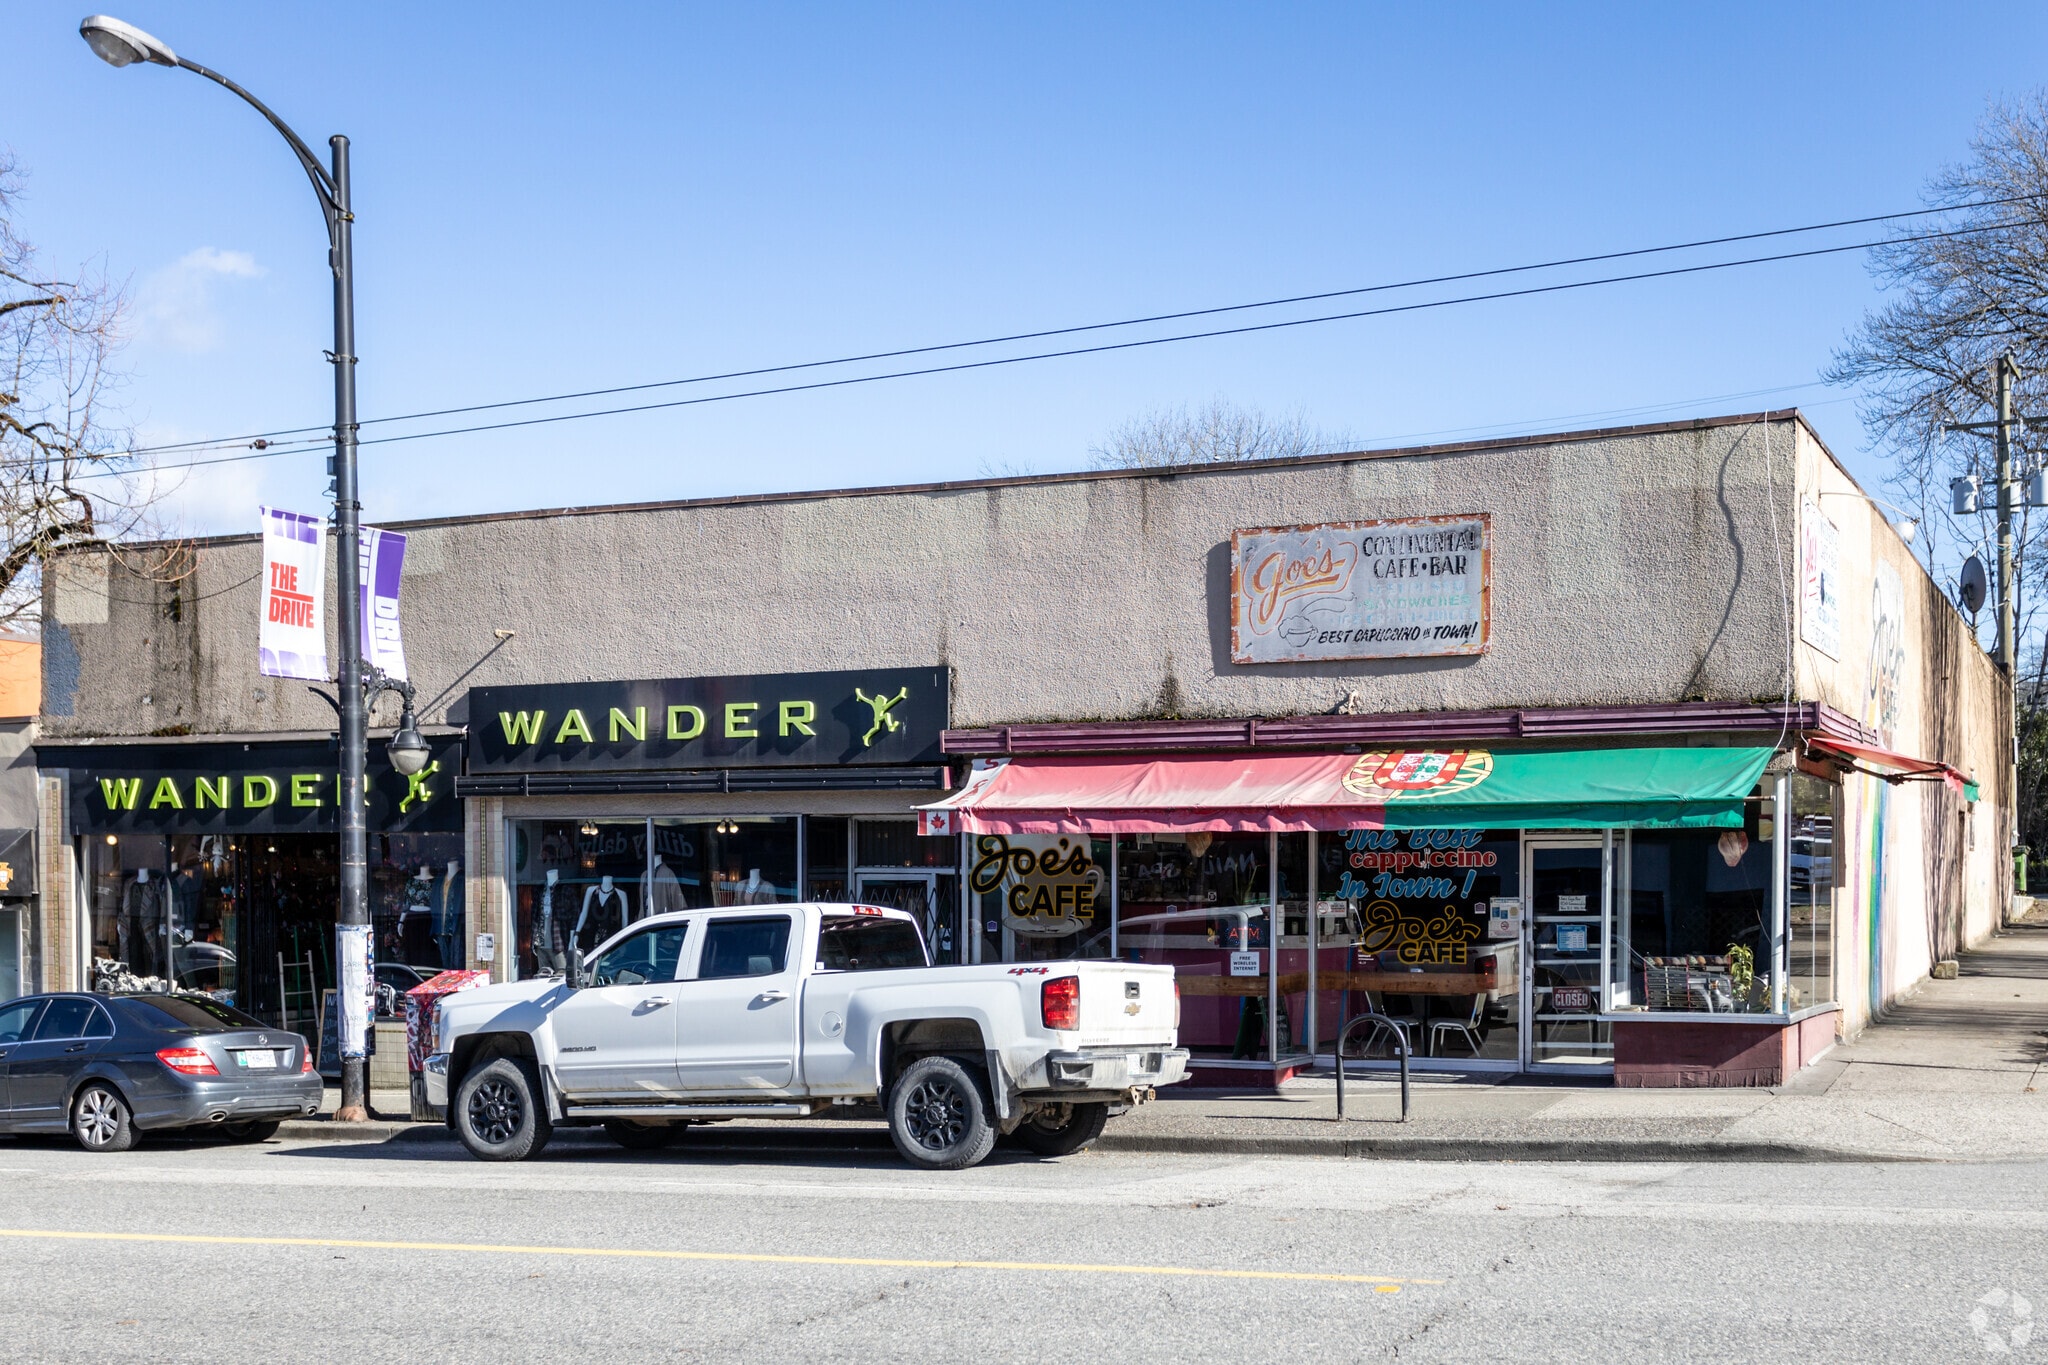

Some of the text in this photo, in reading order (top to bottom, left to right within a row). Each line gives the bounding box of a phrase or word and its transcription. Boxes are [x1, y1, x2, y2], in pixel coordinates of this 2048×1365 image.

[270, 561, 298, 592] THE
[1373, 554, 1468, 580] CAFE BAR
[268, 596, 315, 629] DRIVE
[1318, 629, 1353, 644] BEST
[1433, 621, 1479, 641] TOWN!
[498, 700, 817, 746] WANDER
[1338, 828, 1485, 850] The Best
[970, 833, 1093, 894] Joe's
[1349, 847, 1498, 874] cappuccino
[1336, 871, 1369, 900] In
[1008, 883, 1095, 919] CAFE
[1229, 927, 1260, 940] ATM
[1360, 899, 1482, 955] Joe's
[1397, 940, 1468, 965] CAFE
[1555, 993, 1588, 1007] CLOSED
